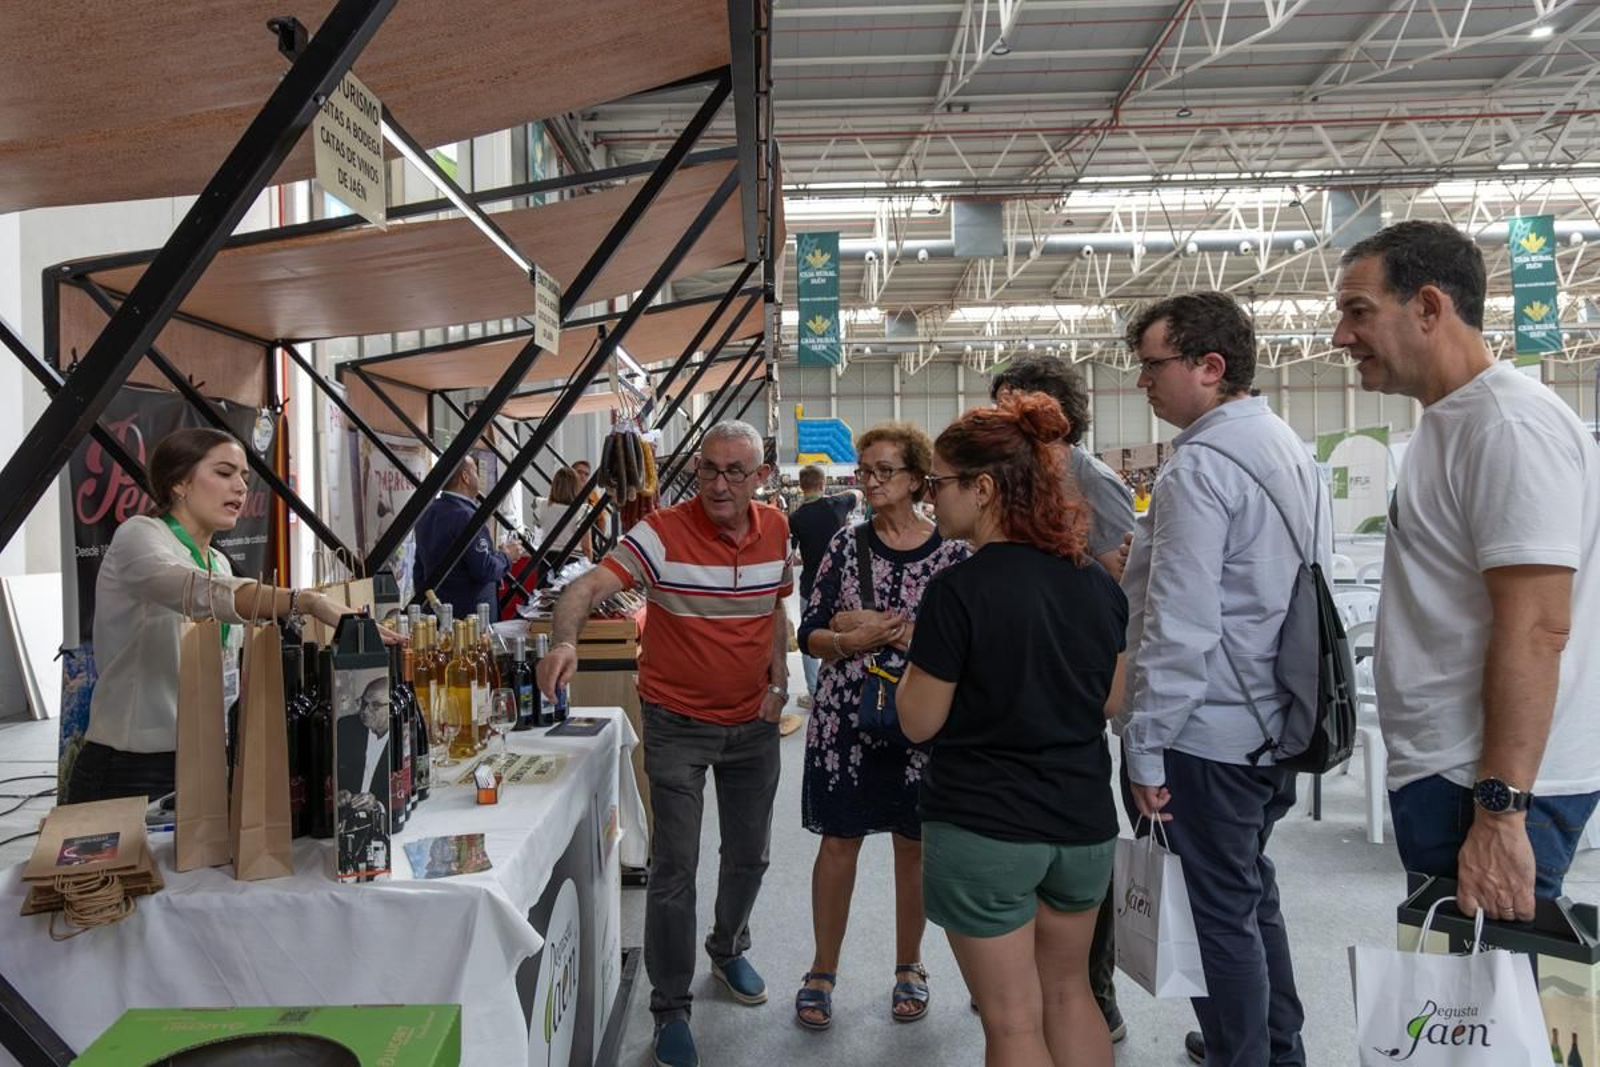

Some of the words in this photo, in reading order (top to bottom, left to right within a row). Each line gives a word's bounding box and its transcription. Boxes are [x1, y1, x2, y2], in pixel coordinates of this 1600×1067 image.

[320, 126, 345, 158] CATAS
[346, 147, 356, 168] DE
[357, 155, 379, 185] VINOS
[345, 118, 351, 134] A
[352, 123, 381, 158] BODEGA
[338, 168, 348, 189] DE
[349, 177, 367, 202] JAÉN
[75, 544, 99, 557] Desde
[1418, 999, 1479, 1020] Degusta
[1392, 1014, 1491, 1062] Jaén
